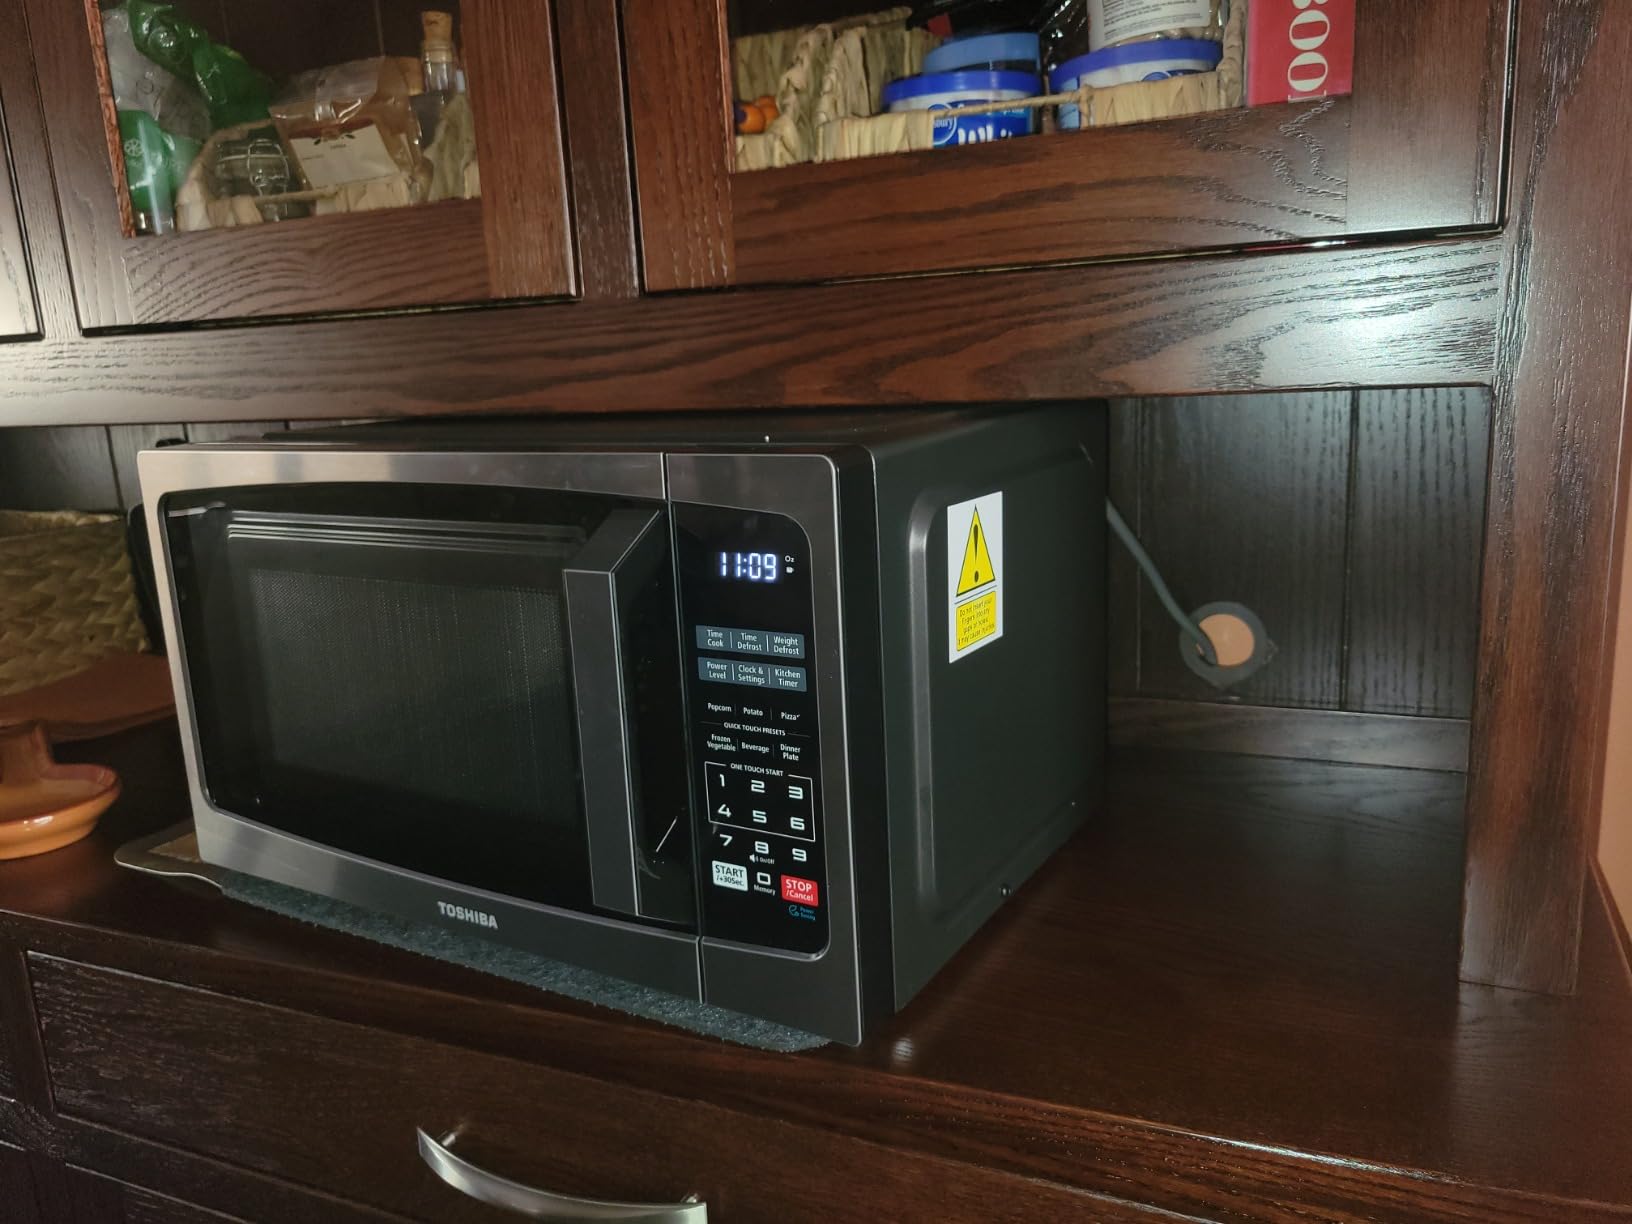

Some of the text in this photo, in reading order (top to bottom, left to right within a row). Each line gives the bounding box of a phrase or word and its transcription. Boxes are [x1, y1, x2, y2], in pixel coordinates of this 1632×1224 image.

[784, 555, 795, 563] Oz
[721, 552, 777, 580] 11:09
[707, 629, 723, 638] Time
[741, 632, 757, 642] Time
[707, 638, 724, 647] Cook
[737, 641, 762, 651] Defrost
[773, 635, 798, 647] Weight
[773, 645, 799, 655] Defrost
[707, 661, 727, 671] Power
[738, 664, 764, 675] Clock &
[709, 670, 726, 679] Level
[738, 674, 765, 685] Settings
[775, 669, 801, 679] Kitchen
[778, 678, 799, 688] Timer
[707, 702, 732, 712] Popcorn
[743, 707, 763, 716] Potato
[724, 722, 786, 736] QUICK TOUCH PRESETS
[711, 734, 731, 742] Frozen
[707, 741, 736, 751] Vegetable
[741, 742, 769, 753] Beverage
[780, 744, 800, 753] Dinner
[783, 752, 799, 761] Plate
[744, 765, 765, 773] TOUCH
[765, 768, 784, 776] START
[719, 773, 725, 787] 1
[751, 780, 765, 793] 2
[788, 785, 803, 800] 3
[718, 804, 732, 818] 4
[752, 810, 767, 824] 5
[790, 817, 805, 831] 6
[719, 834, 733, 846] 7
[754, 841, 769, 854] 8
[792, 848, 807, 862] 9
[715, 864, 744, 878] START
[757, 872, 771, 885] 0
[753, 884, 776, 896] Memory
[785, 879, 812, 893] STOP
[437, 901, 499, 930] TOSHIBA
